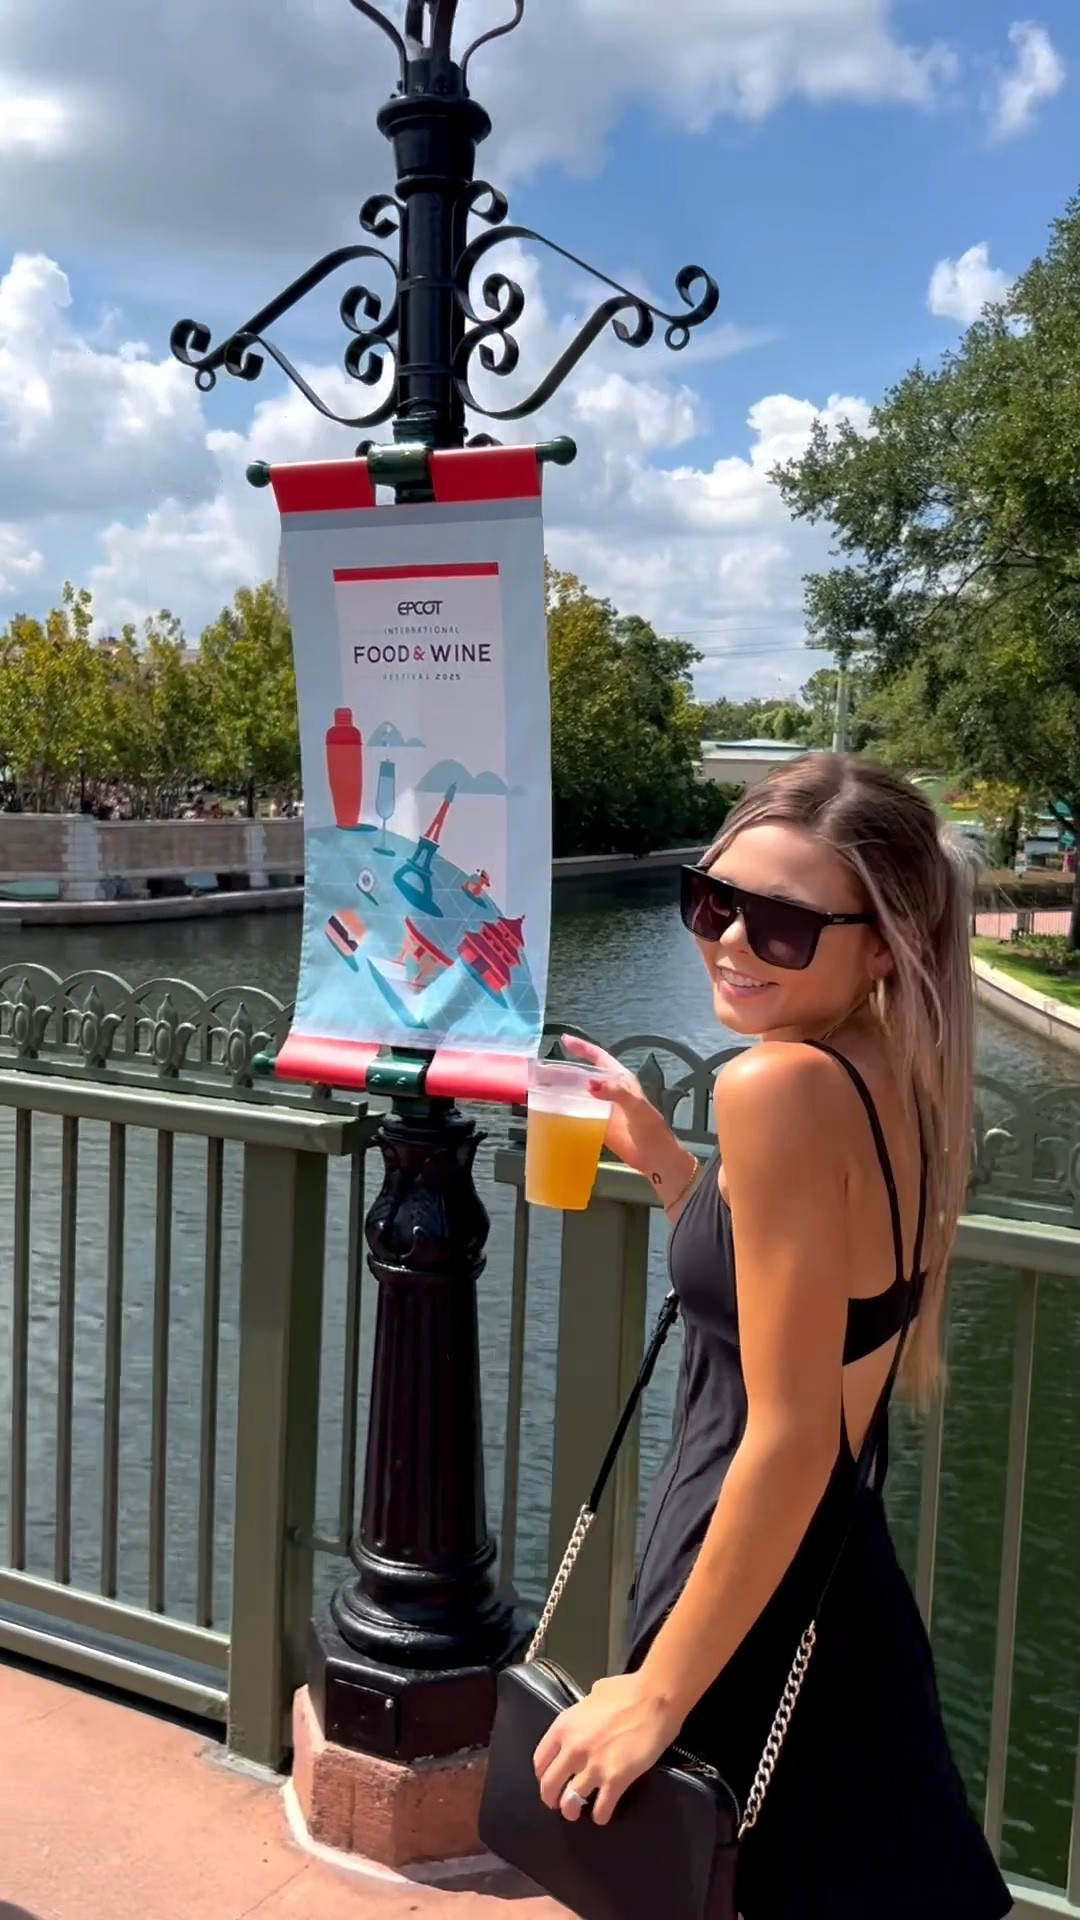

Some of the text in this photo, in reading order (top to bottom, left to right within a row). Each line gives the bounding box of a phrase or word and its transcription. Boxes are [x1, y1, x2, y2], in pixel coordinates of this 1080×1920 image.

[397, 600, 444, 616] EPCOT
[384, 625, 460, 635] INTERNATIONAL
[353, 643, 492, 664] FOOD & WINE
[383, 673, 462, 681] FESTIVAL 2025
